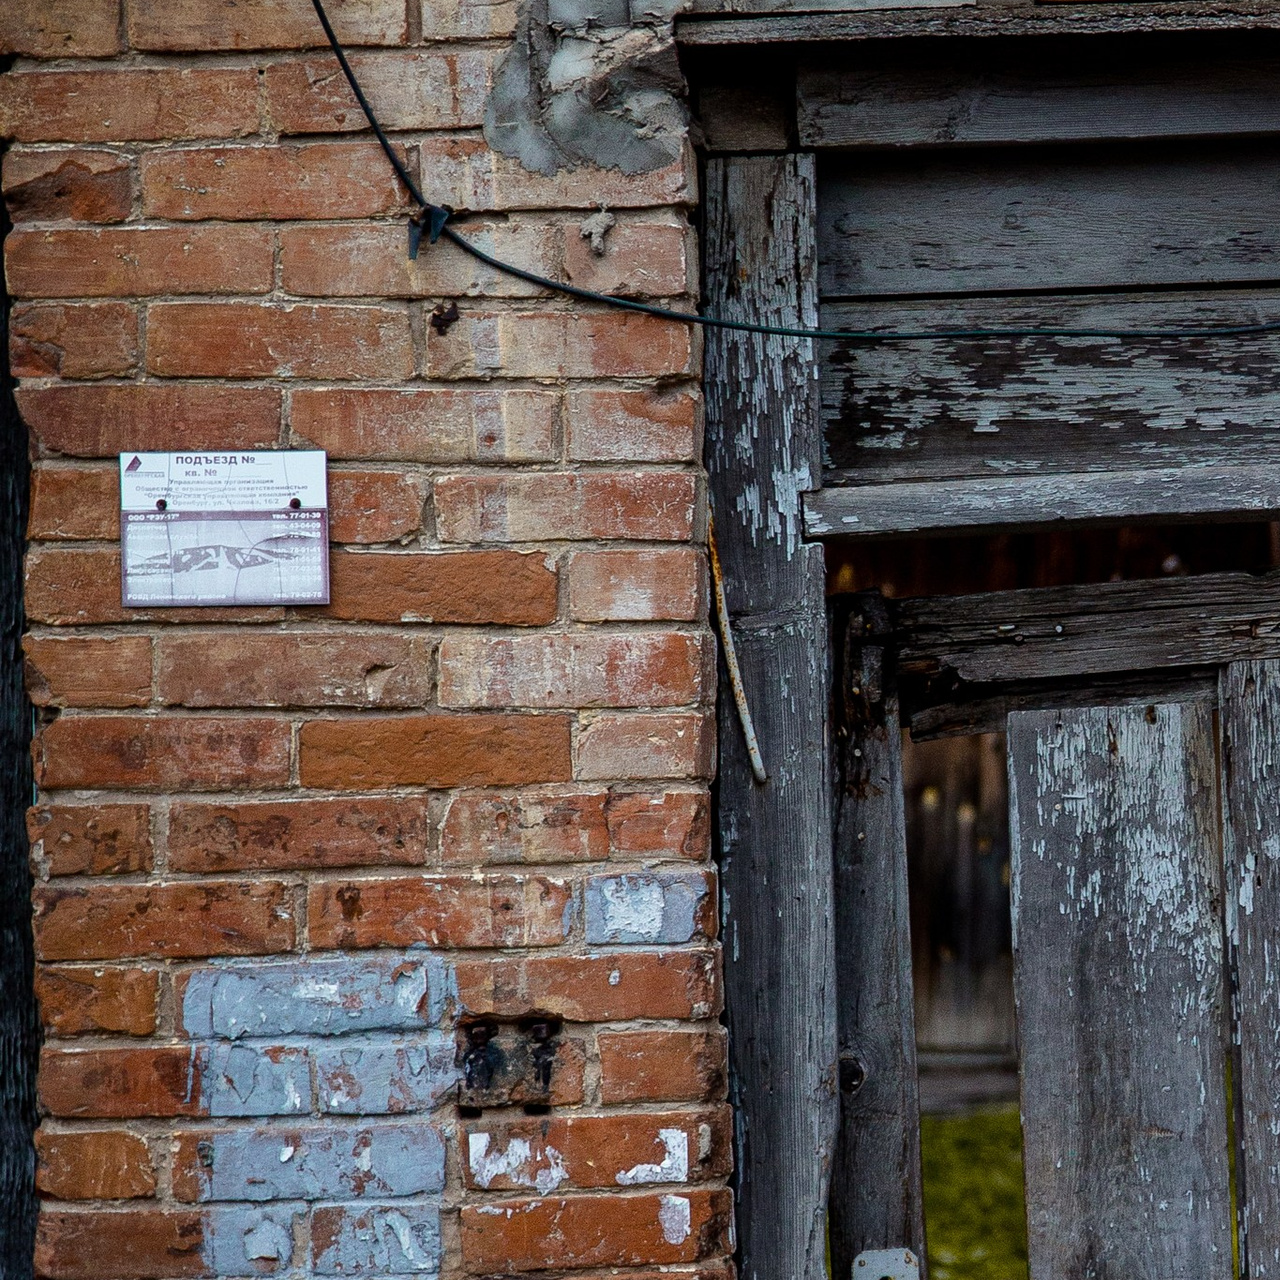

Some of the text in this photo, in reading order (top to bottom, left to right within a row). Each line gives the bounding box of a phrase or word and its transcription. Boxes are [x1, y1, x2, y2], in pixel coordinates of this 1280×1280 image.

[175, 455, 238, 466] ПОДЪЕЗД
[184, 469, 201, 477] кв.
[127, 513, 146, 521] ООО
